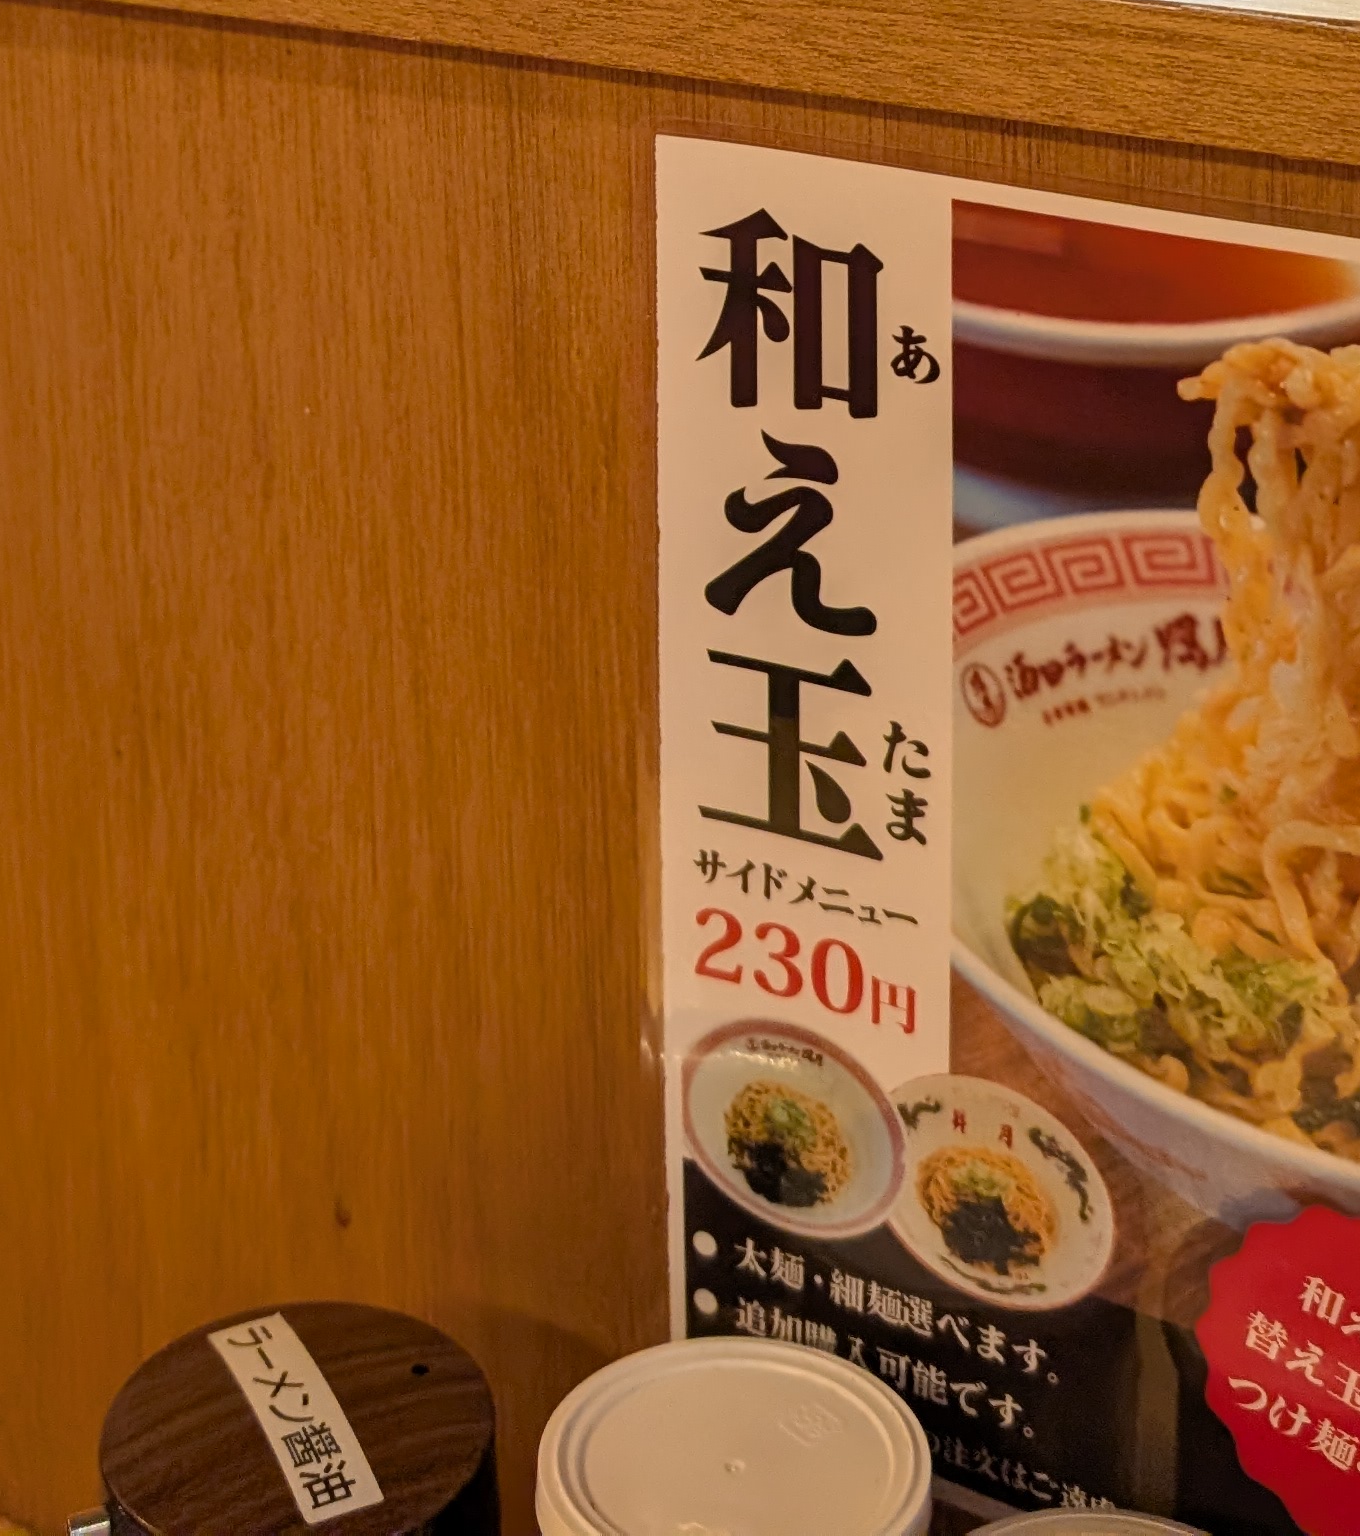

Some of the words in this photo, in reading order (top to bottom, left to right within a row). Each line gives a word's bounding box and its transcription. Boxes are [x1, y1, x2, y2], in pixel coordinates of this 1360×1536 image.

[889, 325, 942, 386] あ
[698, 208, 886, 860] 和え玉
[882, 721, 930, 847] たま
[693, 850, 919, 928] サイドメニュー
[694, 907, 919, 1036] 230円
[735, 1237, 1060, 1386] 太麺・細麺選べます。
[226, 1324, 358, 1511] ラーメン醤油
